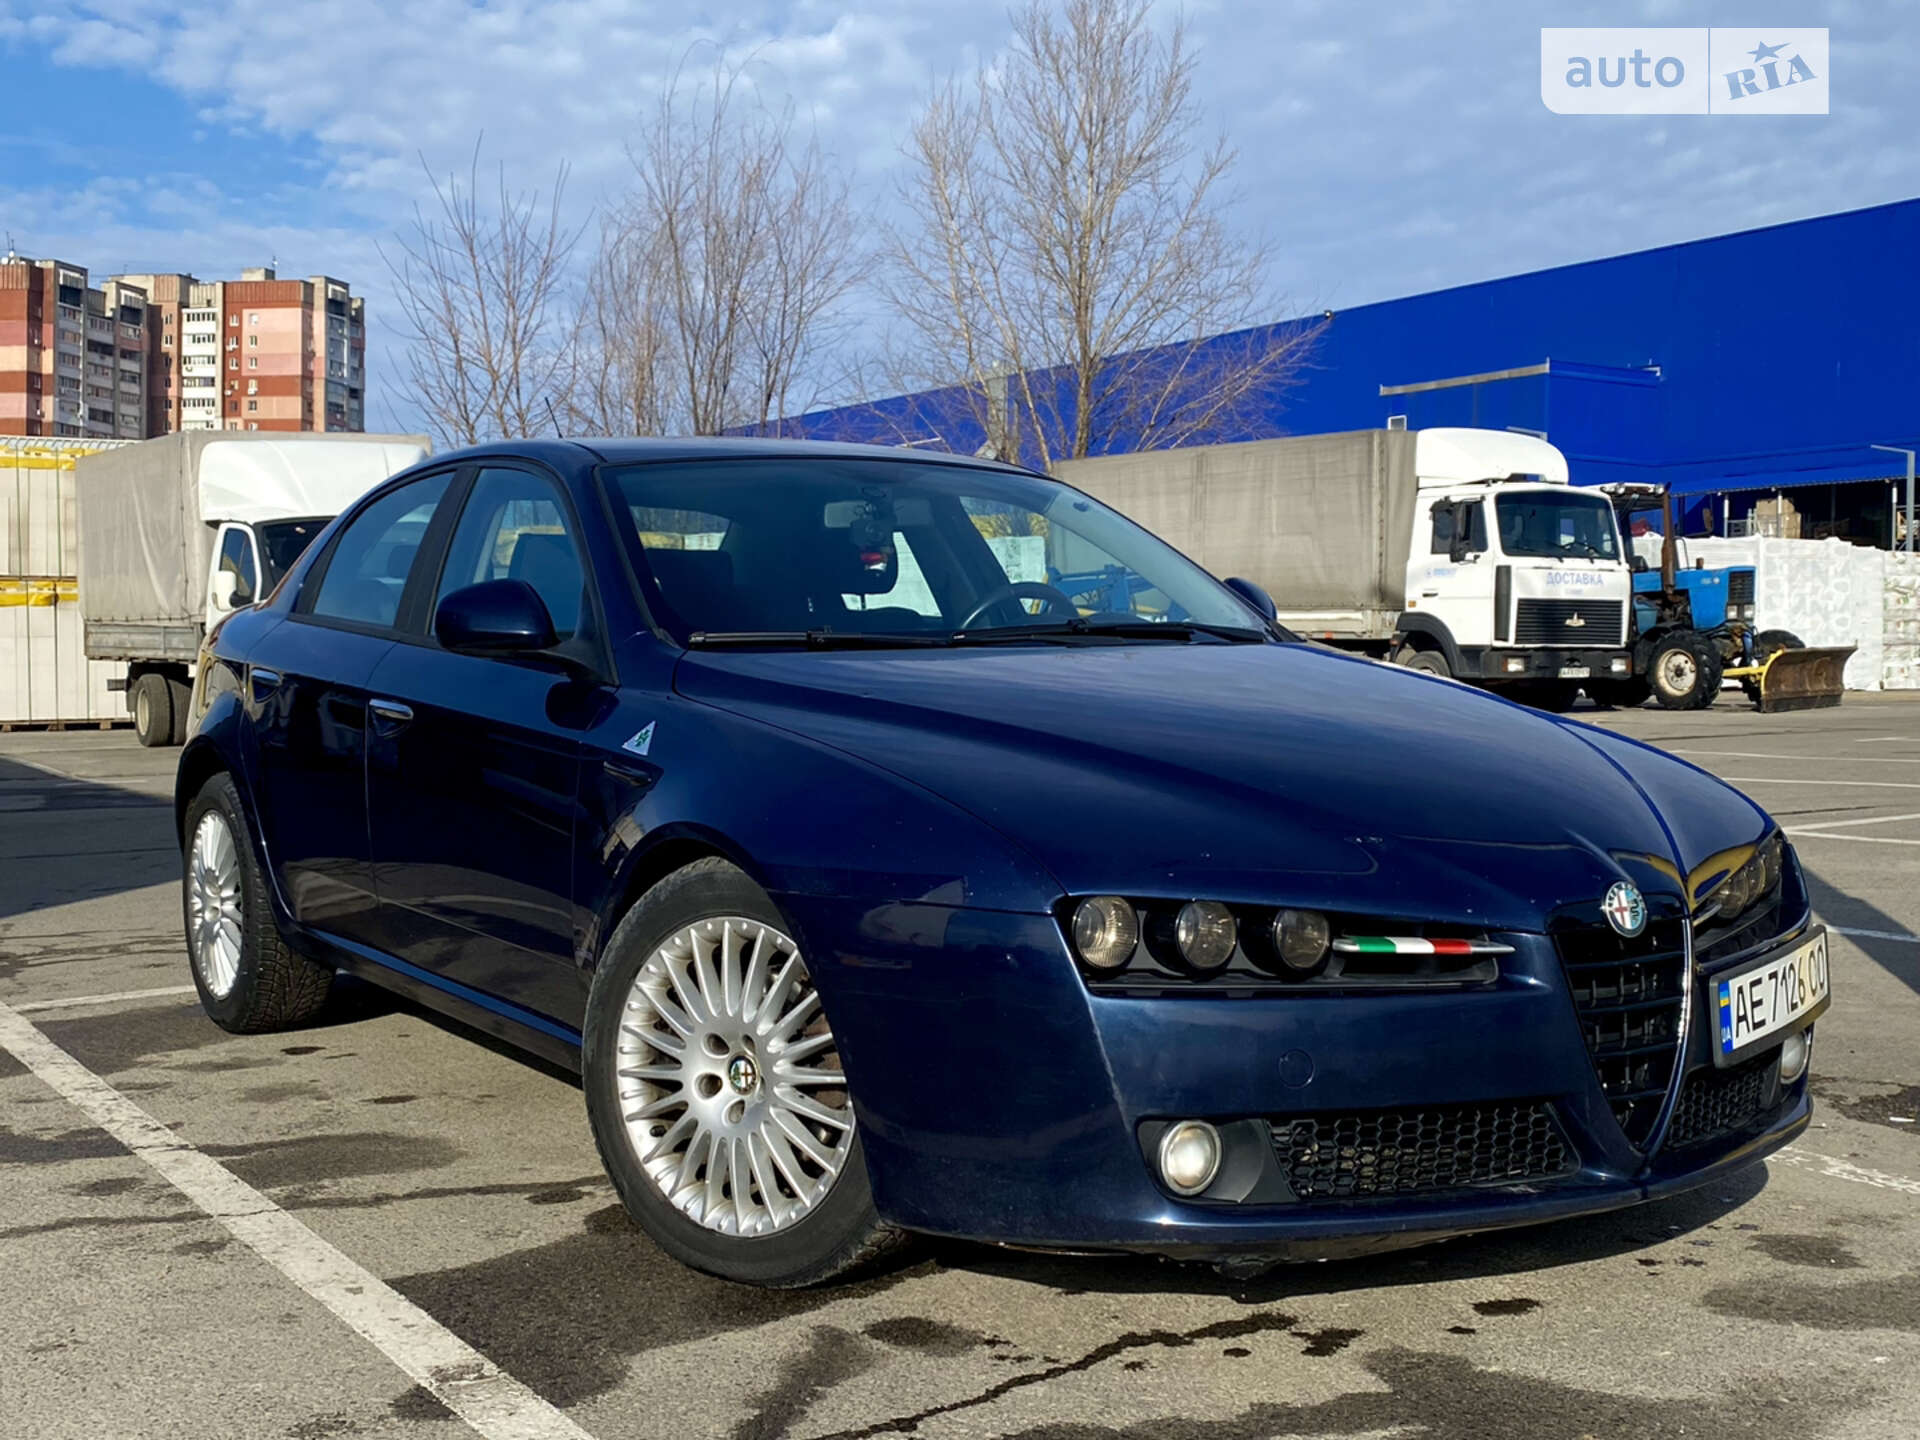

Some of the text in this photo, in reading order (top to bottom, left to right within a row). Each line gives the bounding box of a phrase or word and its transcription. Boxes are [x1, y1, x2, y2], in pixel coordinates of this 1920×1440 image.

[1546, 571, 1604, 585] ДОСТАВКА
[1735, 976, 1766, 1039] AE
[1768, 956, 1806, 1022] 7126
